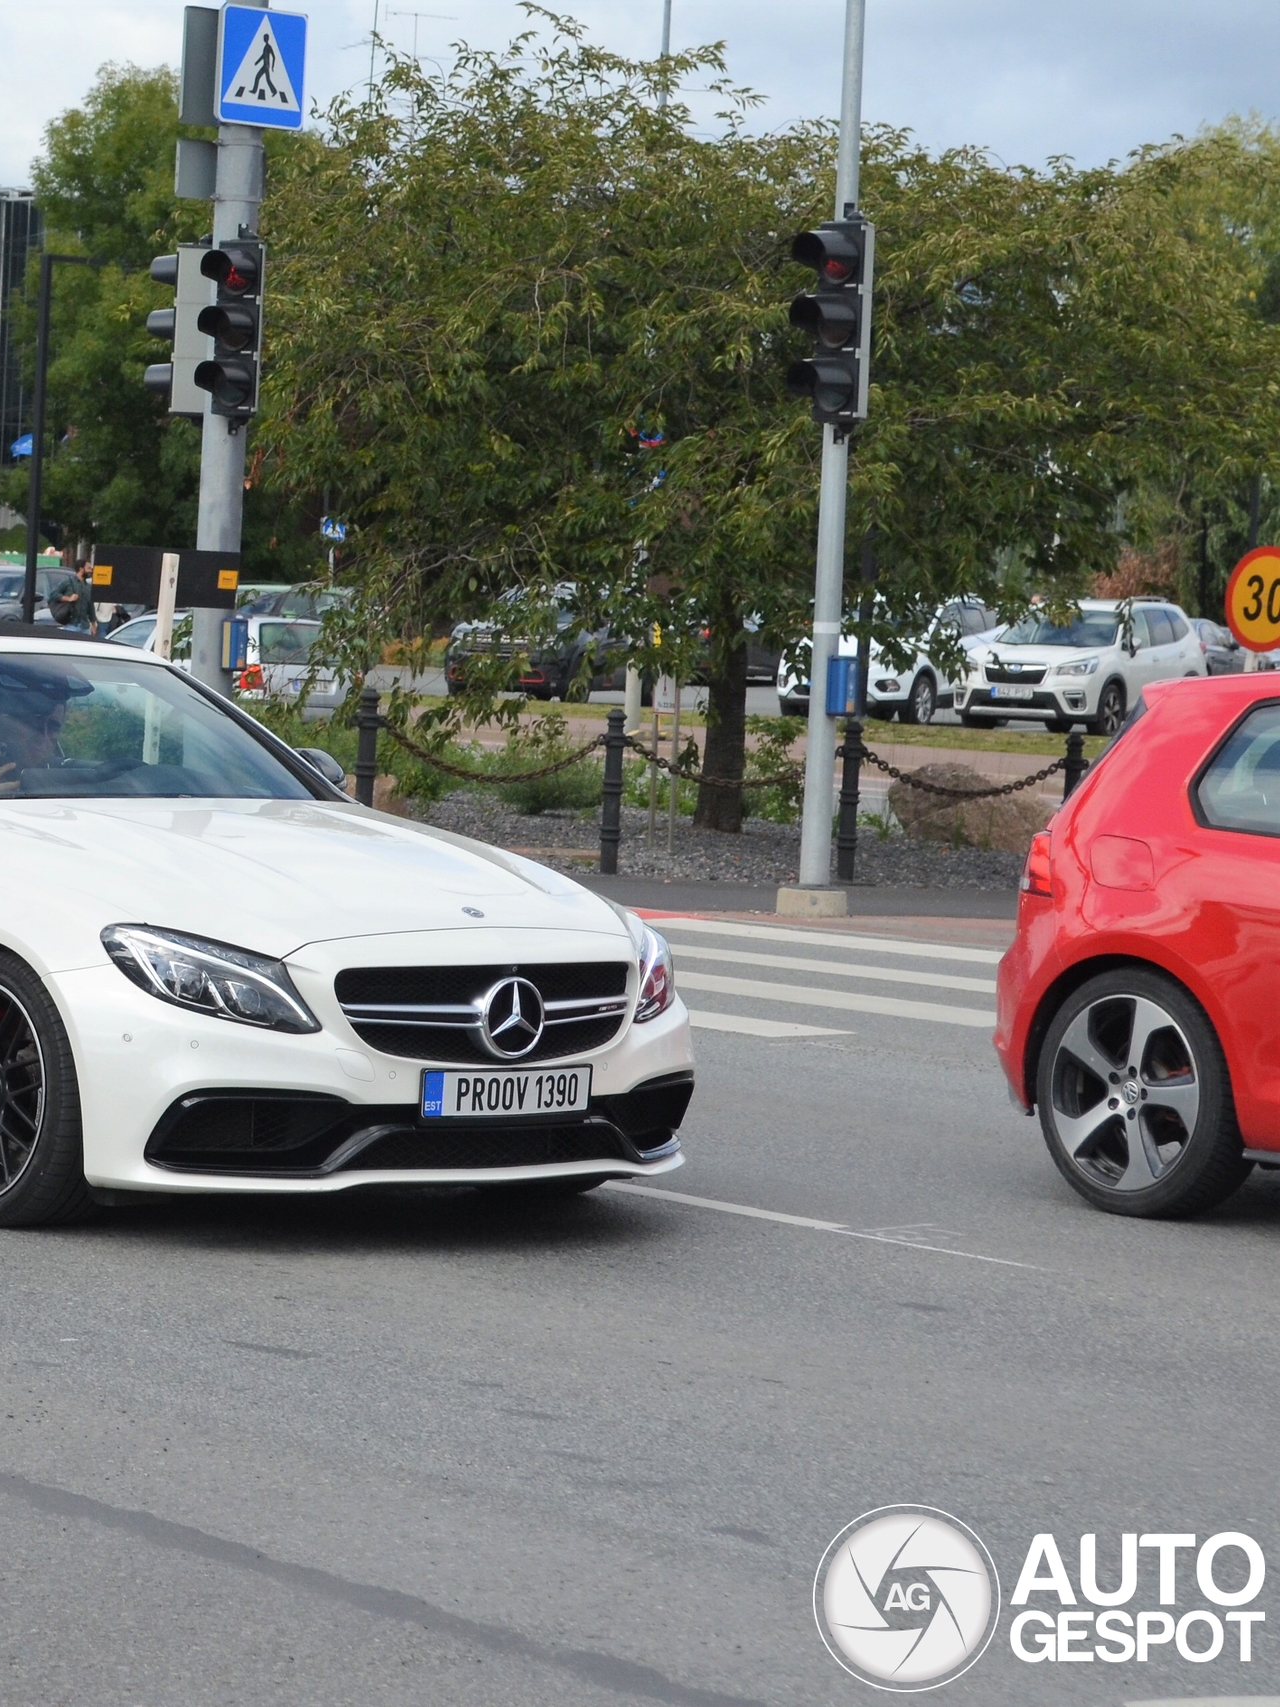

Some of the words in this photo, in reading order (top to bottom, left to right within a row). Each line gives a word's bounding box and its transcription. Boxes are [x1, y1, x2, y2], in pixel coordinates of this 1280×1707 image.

[1243, 575, 1280, 624] 30
[425, 1101, 441, 1111] EST
[456, 1077, 529, 1112] PROOV
[535, 1073, 579, 1109] 1390
